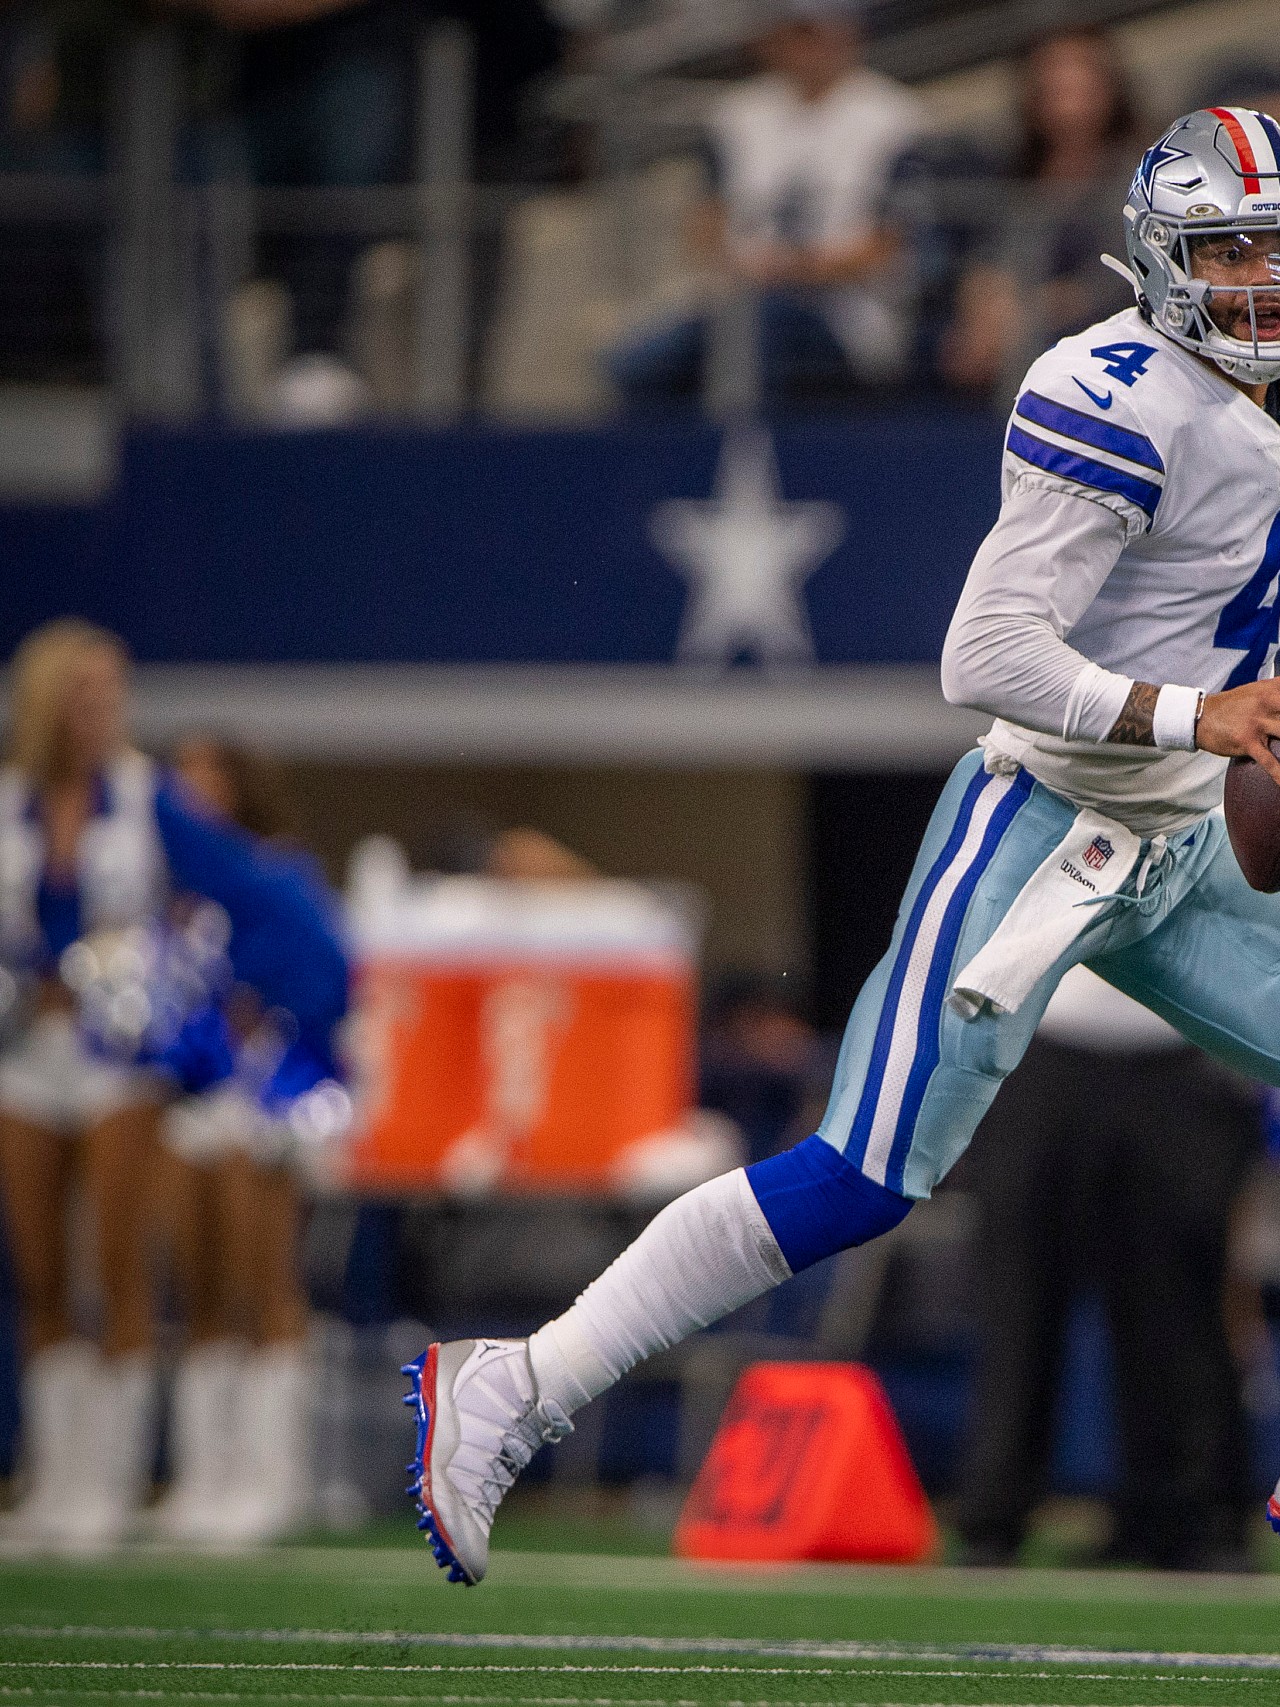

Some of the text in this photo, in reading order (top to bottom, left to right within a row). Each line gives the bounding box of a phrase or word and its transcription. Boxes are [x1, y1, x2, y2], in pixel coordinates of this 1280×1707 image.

[1090, 342, 1159, 387] 4
[1083, 844, 1105, 869] NFL
[1060, 858, 1096, 891] Wilson
